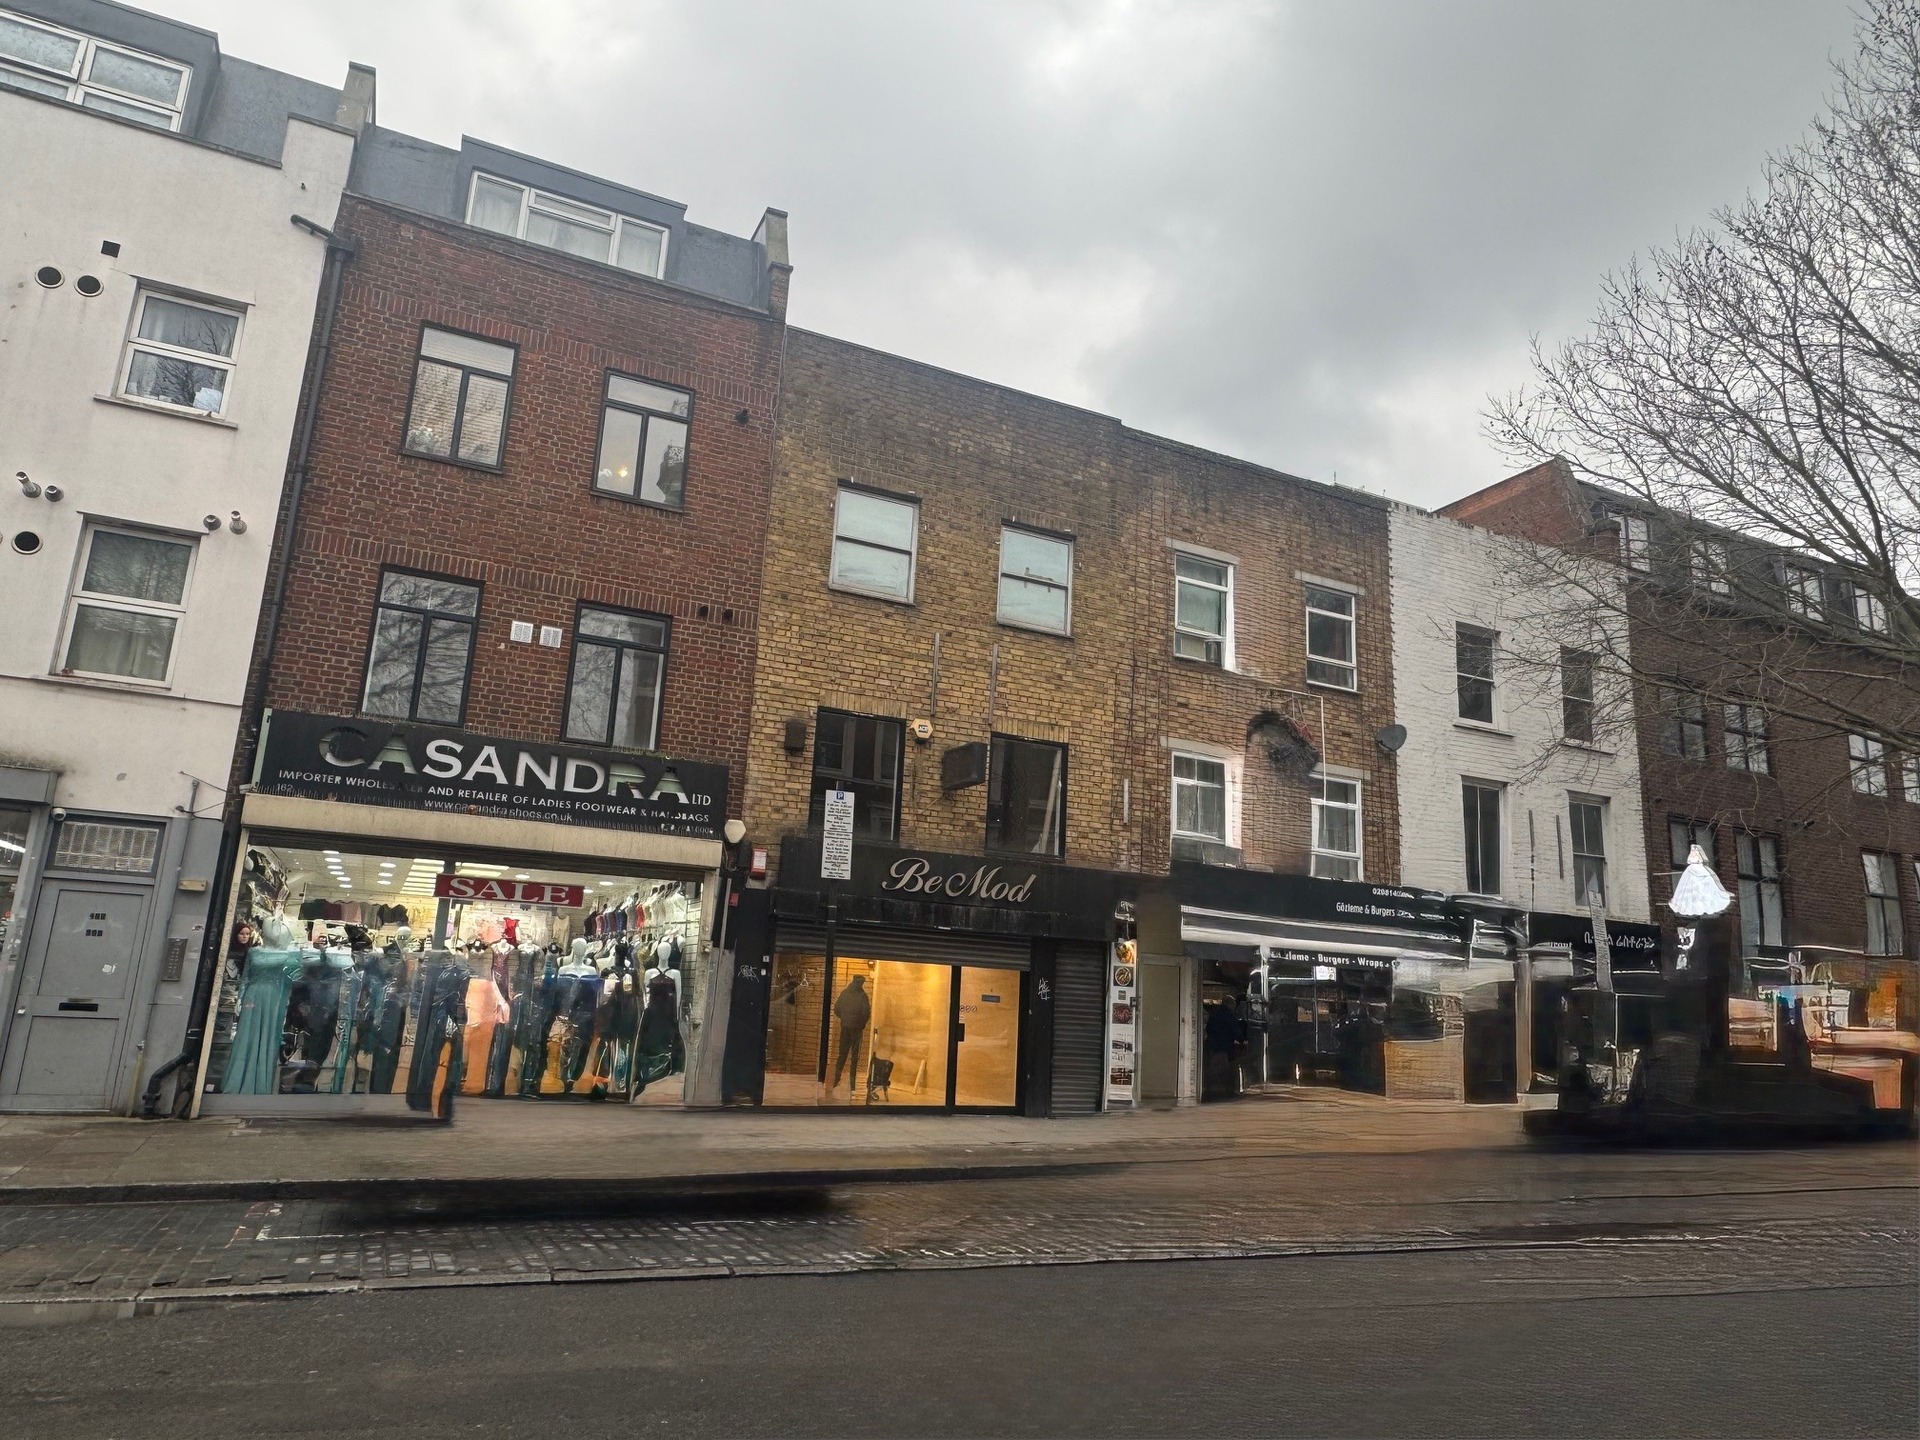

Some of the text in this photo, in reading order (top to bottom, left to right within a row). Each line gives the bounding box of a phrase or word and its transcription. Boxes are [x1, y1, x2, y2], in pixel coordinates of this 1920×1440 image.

[318, 727, 712, 806] CASANDRA LTD
[278, 769, 342, 785] IMPORTER
[345, 777, 424, 793] WHOLESER
[427, 786, 454, 796] AND
[458, 789, 508, 802] RETAILER
[513, 795, 529, 804] OF
[532, 797, 571, 809] LADIES
[575, 801, 637, 816] FOOTWEAR
[449, 877, 570, 905] SALE
[881, 857, 1037, 903] Be Mod
[1371, 905, 1395, 917] Burgers
